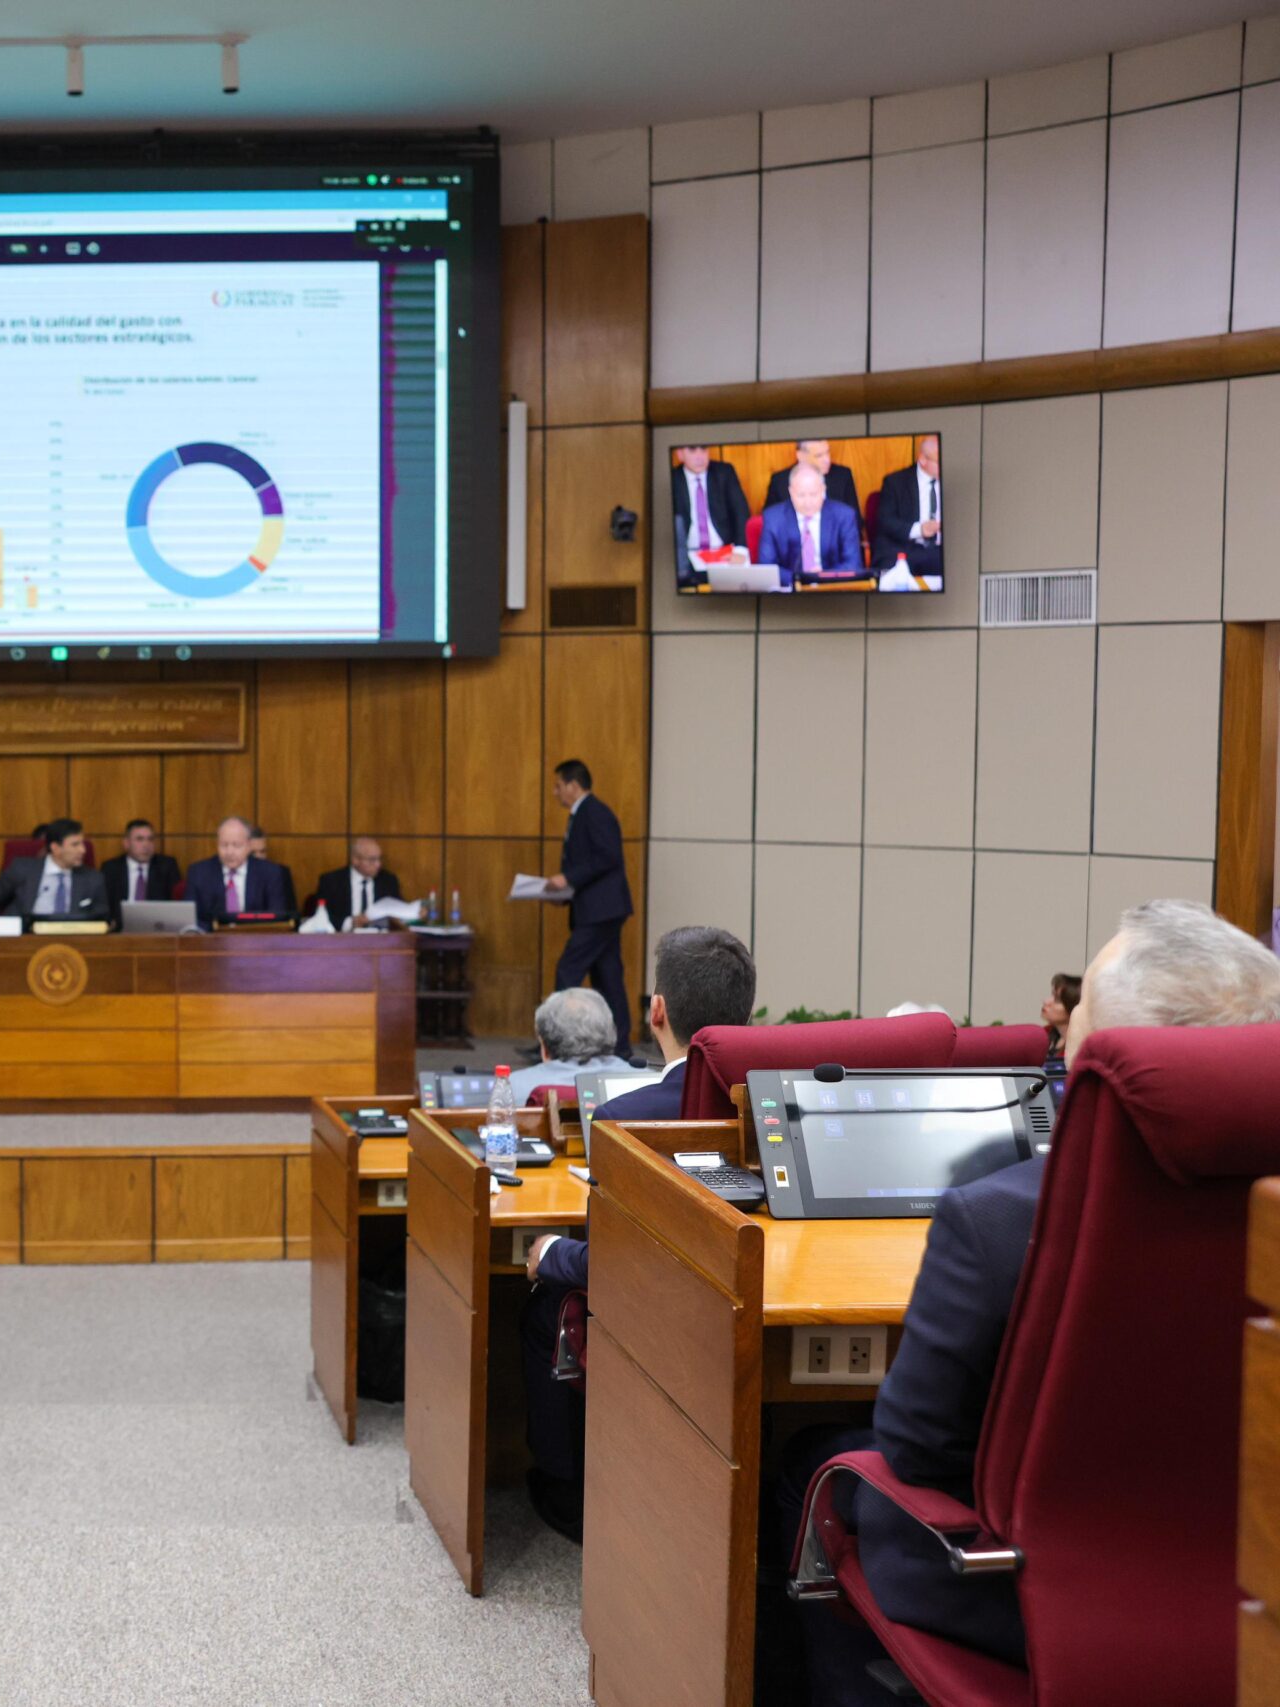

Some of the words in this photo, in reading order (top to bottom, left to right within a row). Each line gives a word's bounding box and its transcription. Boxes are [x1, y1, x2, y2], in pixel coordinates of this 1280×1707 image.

[10, 319, 26, 328] en
[30, 316, 40, 327] la
[45, 316, 92, 327] calidad
[95, 315, 116, 326] del
[120, 317, 154, 329] gasto
[158, 317, 182, 326] con
[12, 333, 27, 344] de
[32, 332, 49, 343] los
[54, 333, 108, 344] sectores
[113, 332, 193, 345] estratégicos.
